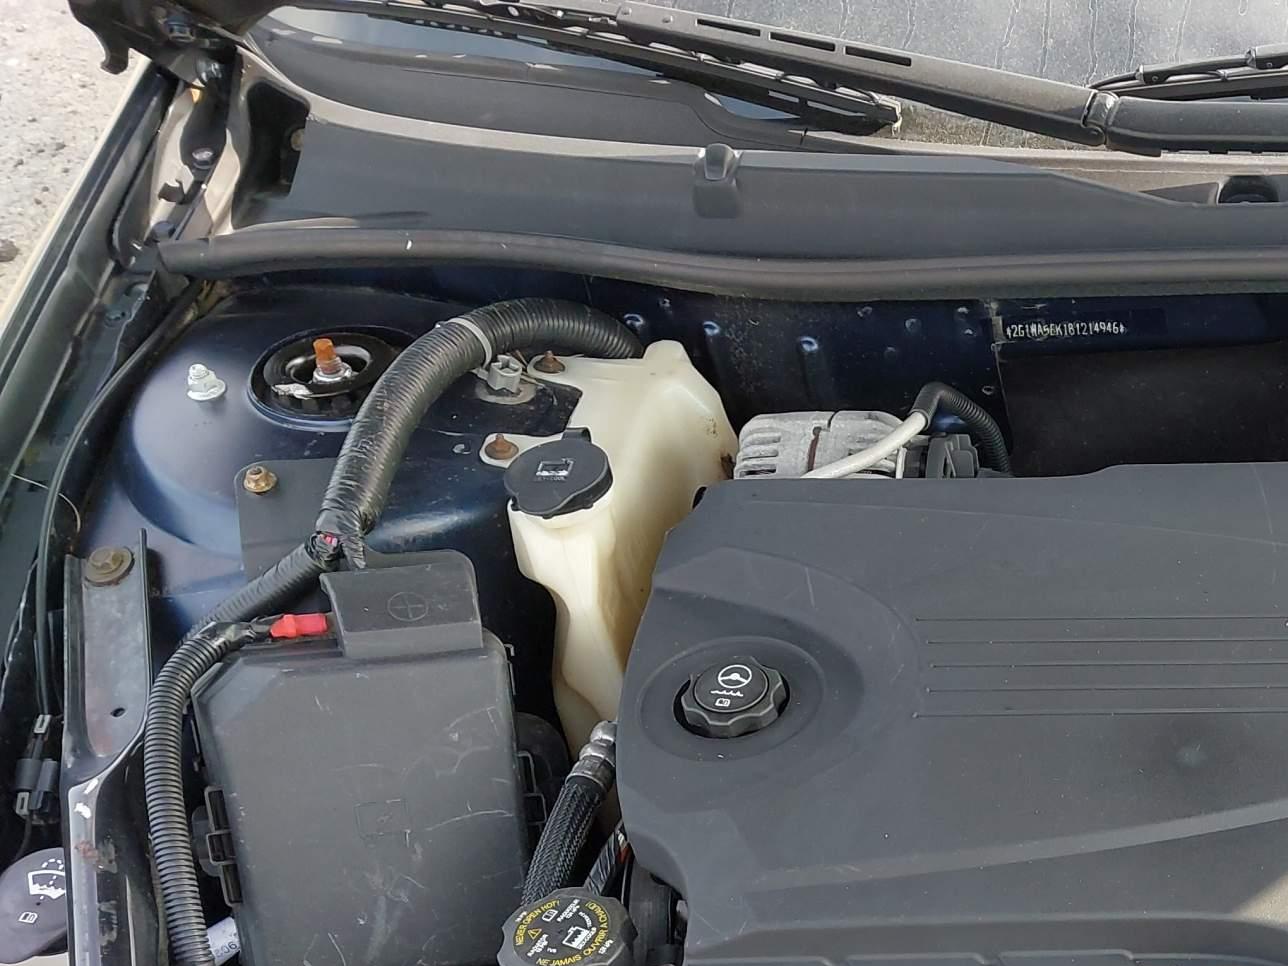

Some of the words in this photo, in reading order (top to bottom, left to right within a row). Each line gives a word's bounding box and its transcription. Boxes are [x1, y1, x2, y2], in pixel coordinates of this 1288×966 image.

[516, 924, 527, 946] NEVER
[524, 908, 542, 925] OPEN
[536, 957, 550, 966] NE
[550, 954, 582, 966] JAMAIS
[583, 930, 608, 957] OUVRIR
